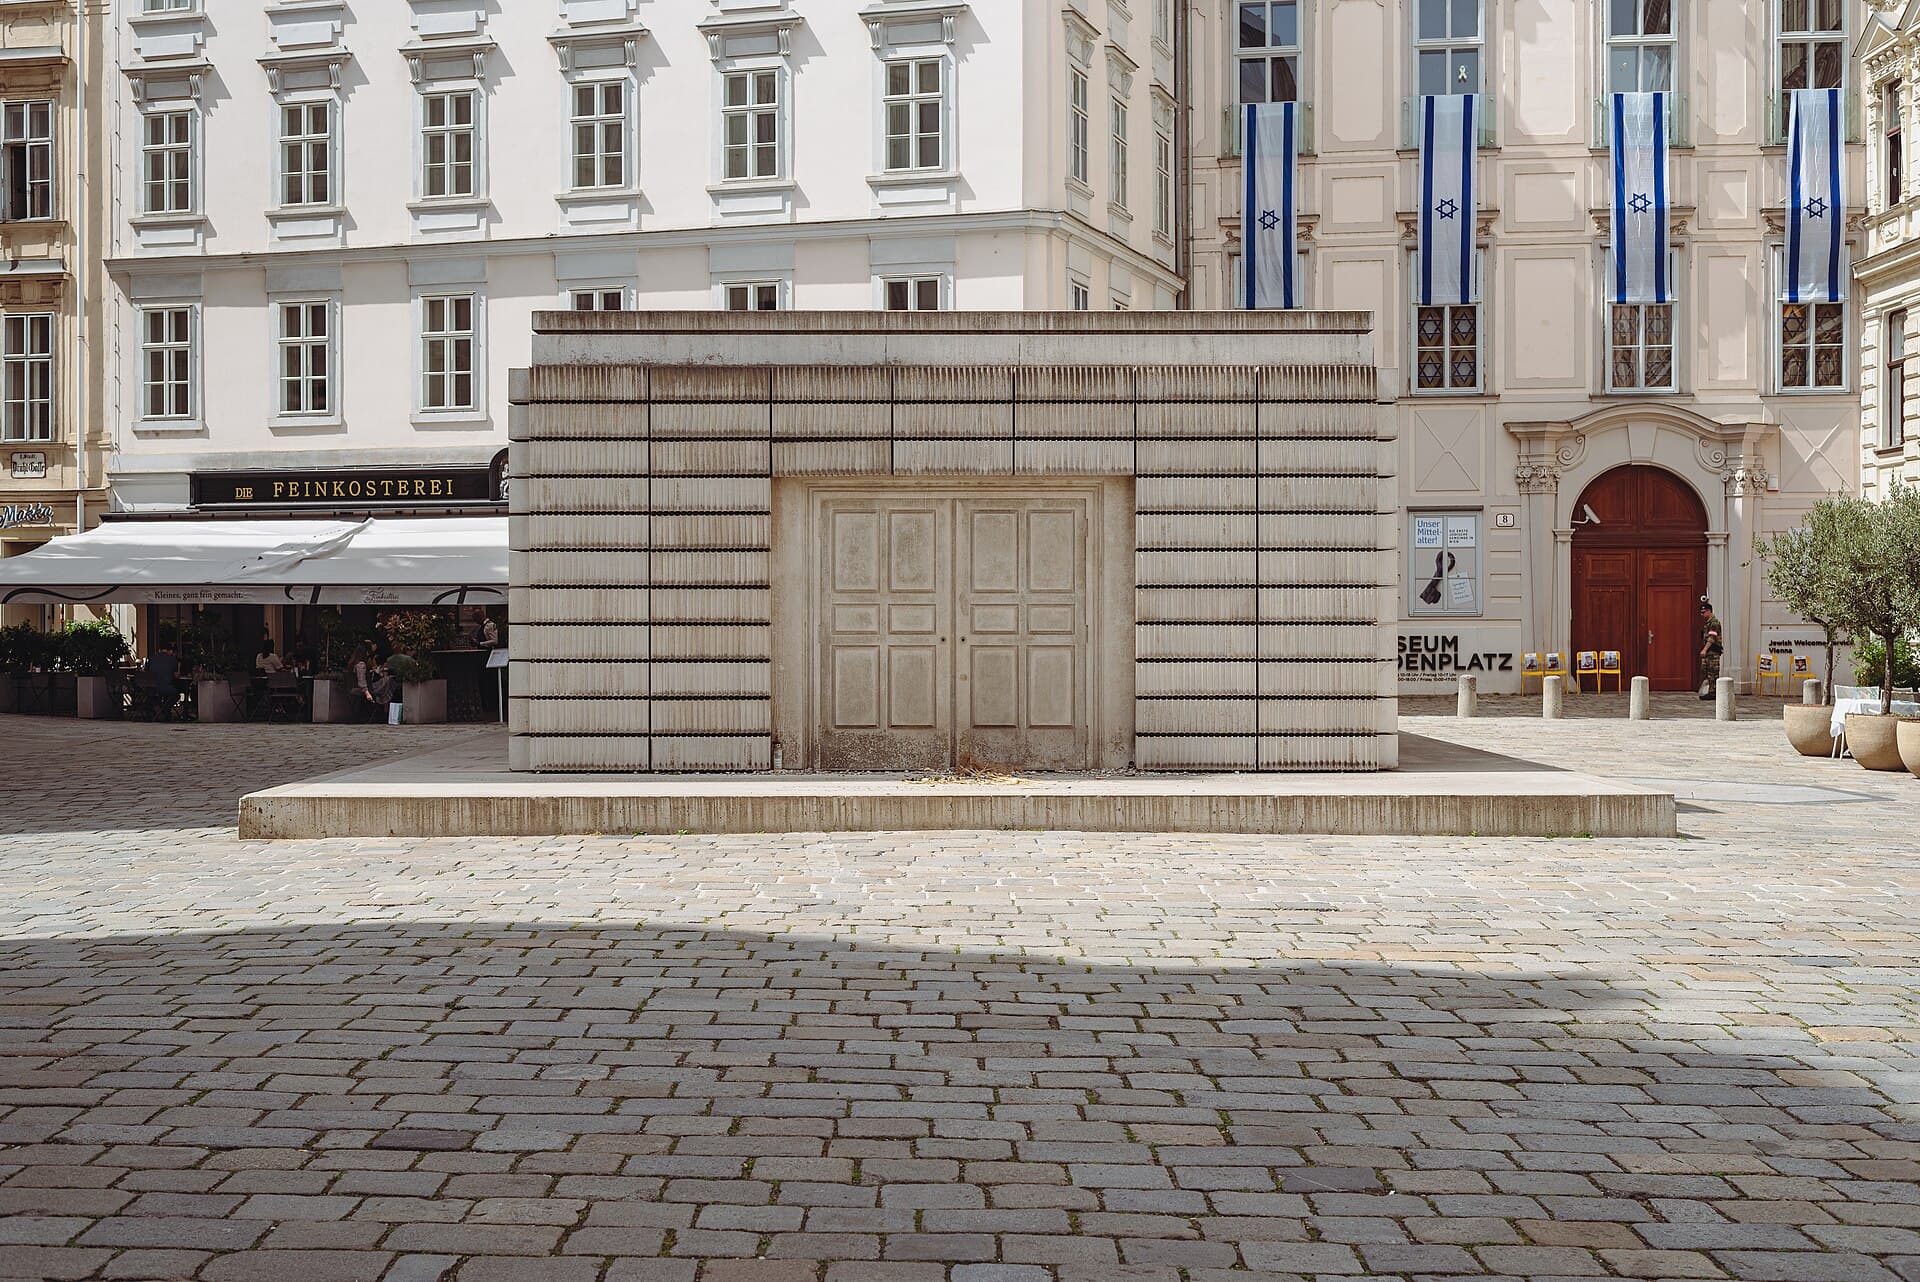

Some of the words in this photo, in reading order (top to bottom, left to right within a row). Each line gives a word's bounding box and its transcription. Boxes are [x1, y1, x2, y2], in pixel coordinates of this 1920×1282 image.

[235, 488, 253, 500] DIE
[273, 480, 453, 497] FEINKOSTEREI
[1502, 515, 1508, 523] 8
[1417, 520, 1440, 528] Unser
[1417, 528, 1442, 536] Mittel-
[1417, 536, 1437, 544] alter!
[154, 591, 181, 599] Kleines,
[182, 592, 198, 601] ganz
[199, 591, 212, 599] fein
[1398, 635, 1458, 653] SEUM
